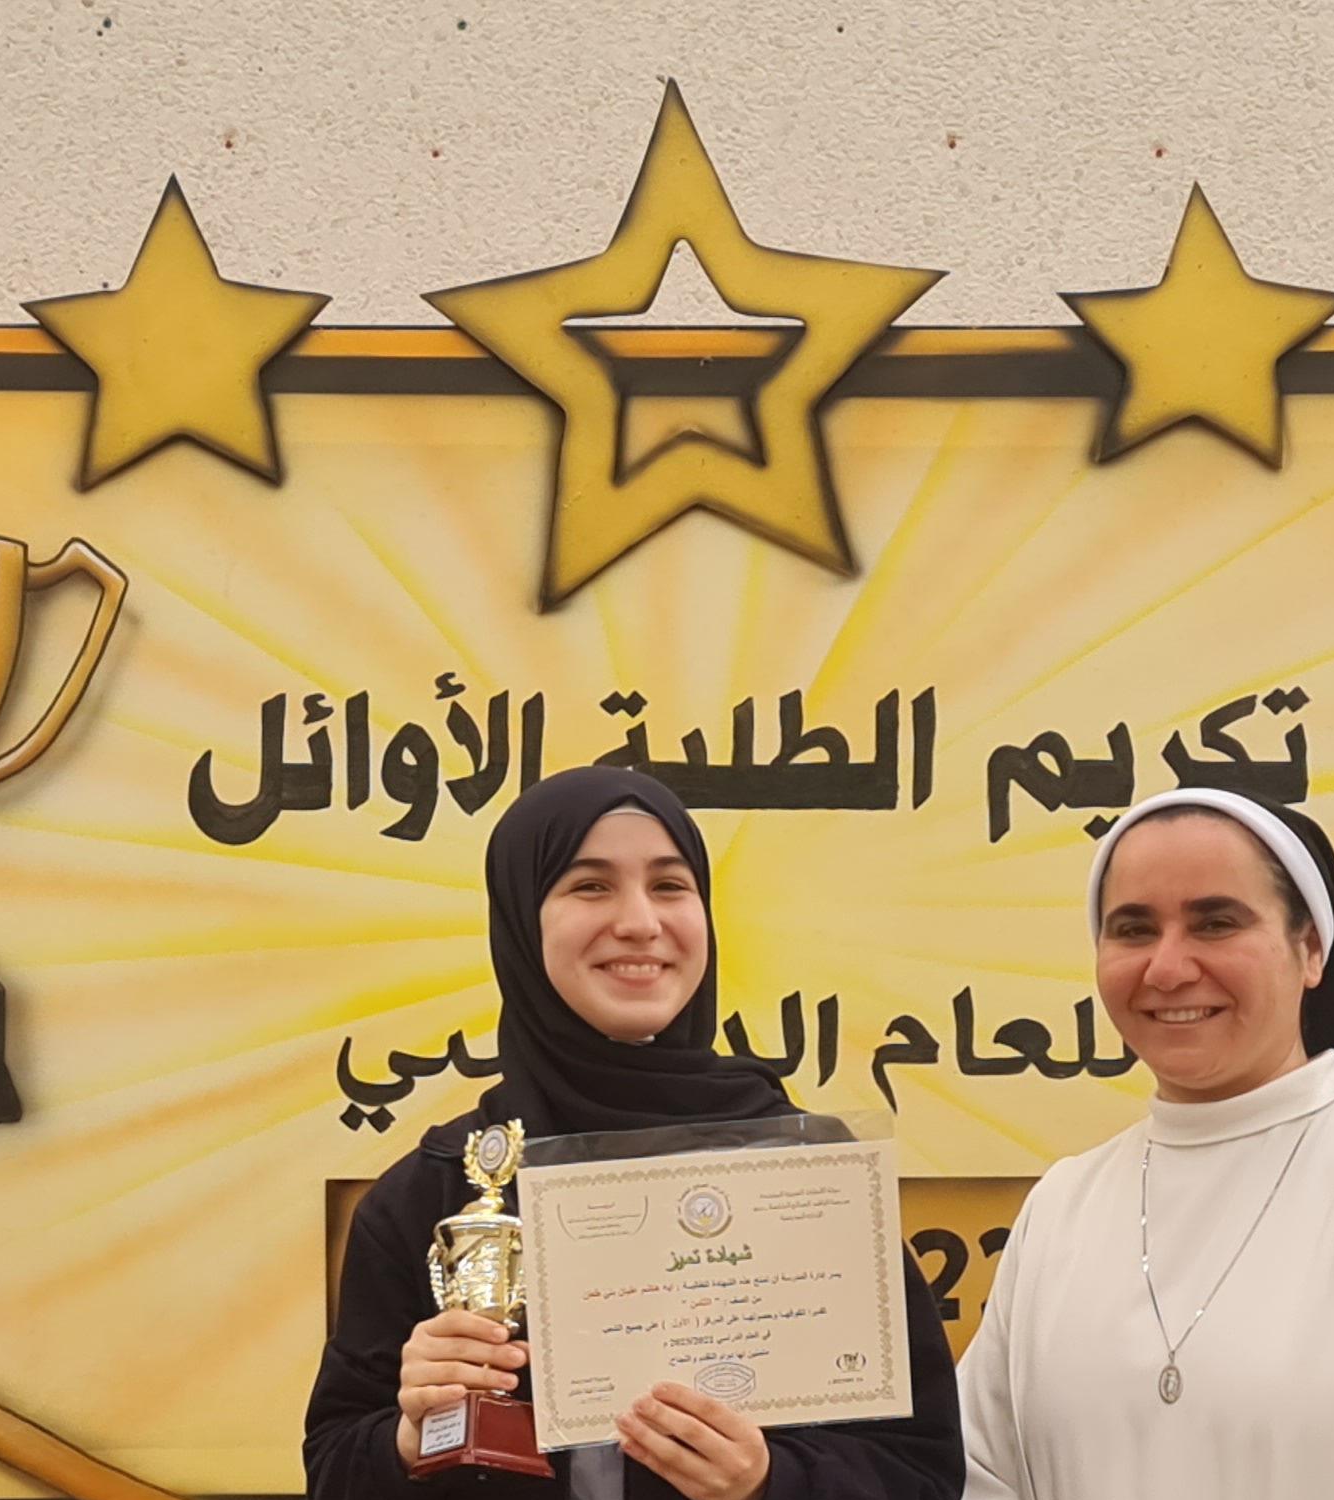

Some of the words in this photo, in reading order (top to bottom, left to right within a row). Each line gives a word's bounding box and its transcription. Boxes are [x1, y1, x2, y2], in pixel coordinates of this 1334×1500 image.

[188, 671, 545, 846] الأوائل
[592, 686, 936, 810] الطلبة
[987, 686, 1310, 844] تكريم
[666, 1248, 701, 1272] تميز
[706, 1243, 753, 1266] شهادة
